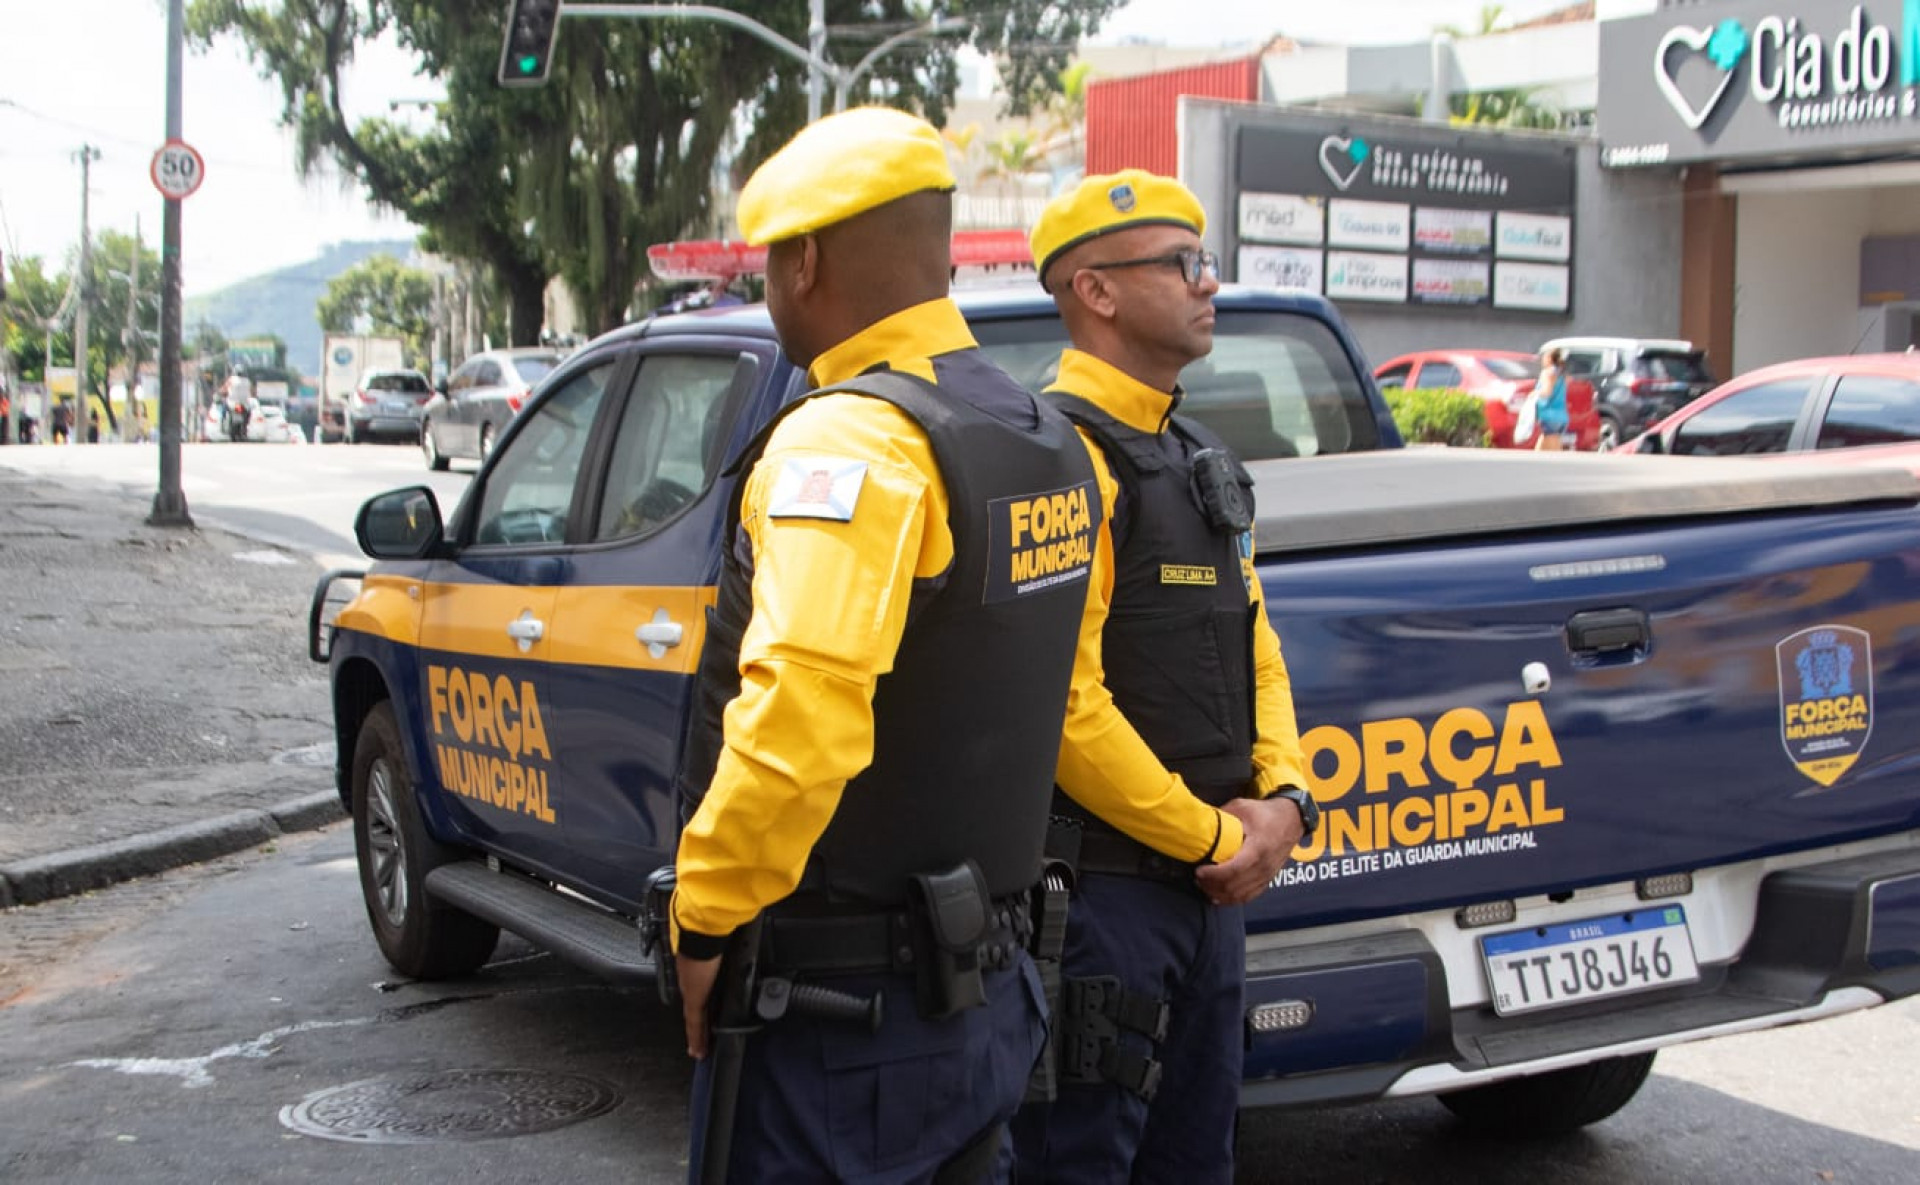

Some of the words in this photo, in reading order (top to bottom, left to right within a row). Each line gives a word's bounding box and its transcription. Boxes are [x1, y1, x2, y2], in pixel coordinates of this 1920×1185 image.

[1751, 15, 1822, 103] Cia
[1832, 4, 1892, 93] do
[1778, 93, 1896, 128] Consultórios
[162, 152, 195, 178] 50
[1010, 486, 1091, 547] FORÇA
[1010, 534, 1091, 583] MUNICIPAL
[428, 664, 552, 761] FORÇA
[1785, 694, 1868, 725] FORÇA
[1786, 716, 1868, 740] MUNICIPAL
[1299, 699, 1563, 803] ORÇA
[437, 743, 556, 824] MUNICIPAL
[1290, 778, 1564, 863] UNICIPAL
[1319, 860, 1339, 881] DE
[1342, 854, 1380, 877] ELITE
[1383, 850, 1403, 870] DA
[1405, 841, 1463, 866] GUARDA
[1464, 830, 1538, 856] MUNICIPAL
[1569, 924, 1604, 941] BRASIL
[1507, 936, 1673, 1003] TTJ8J46
